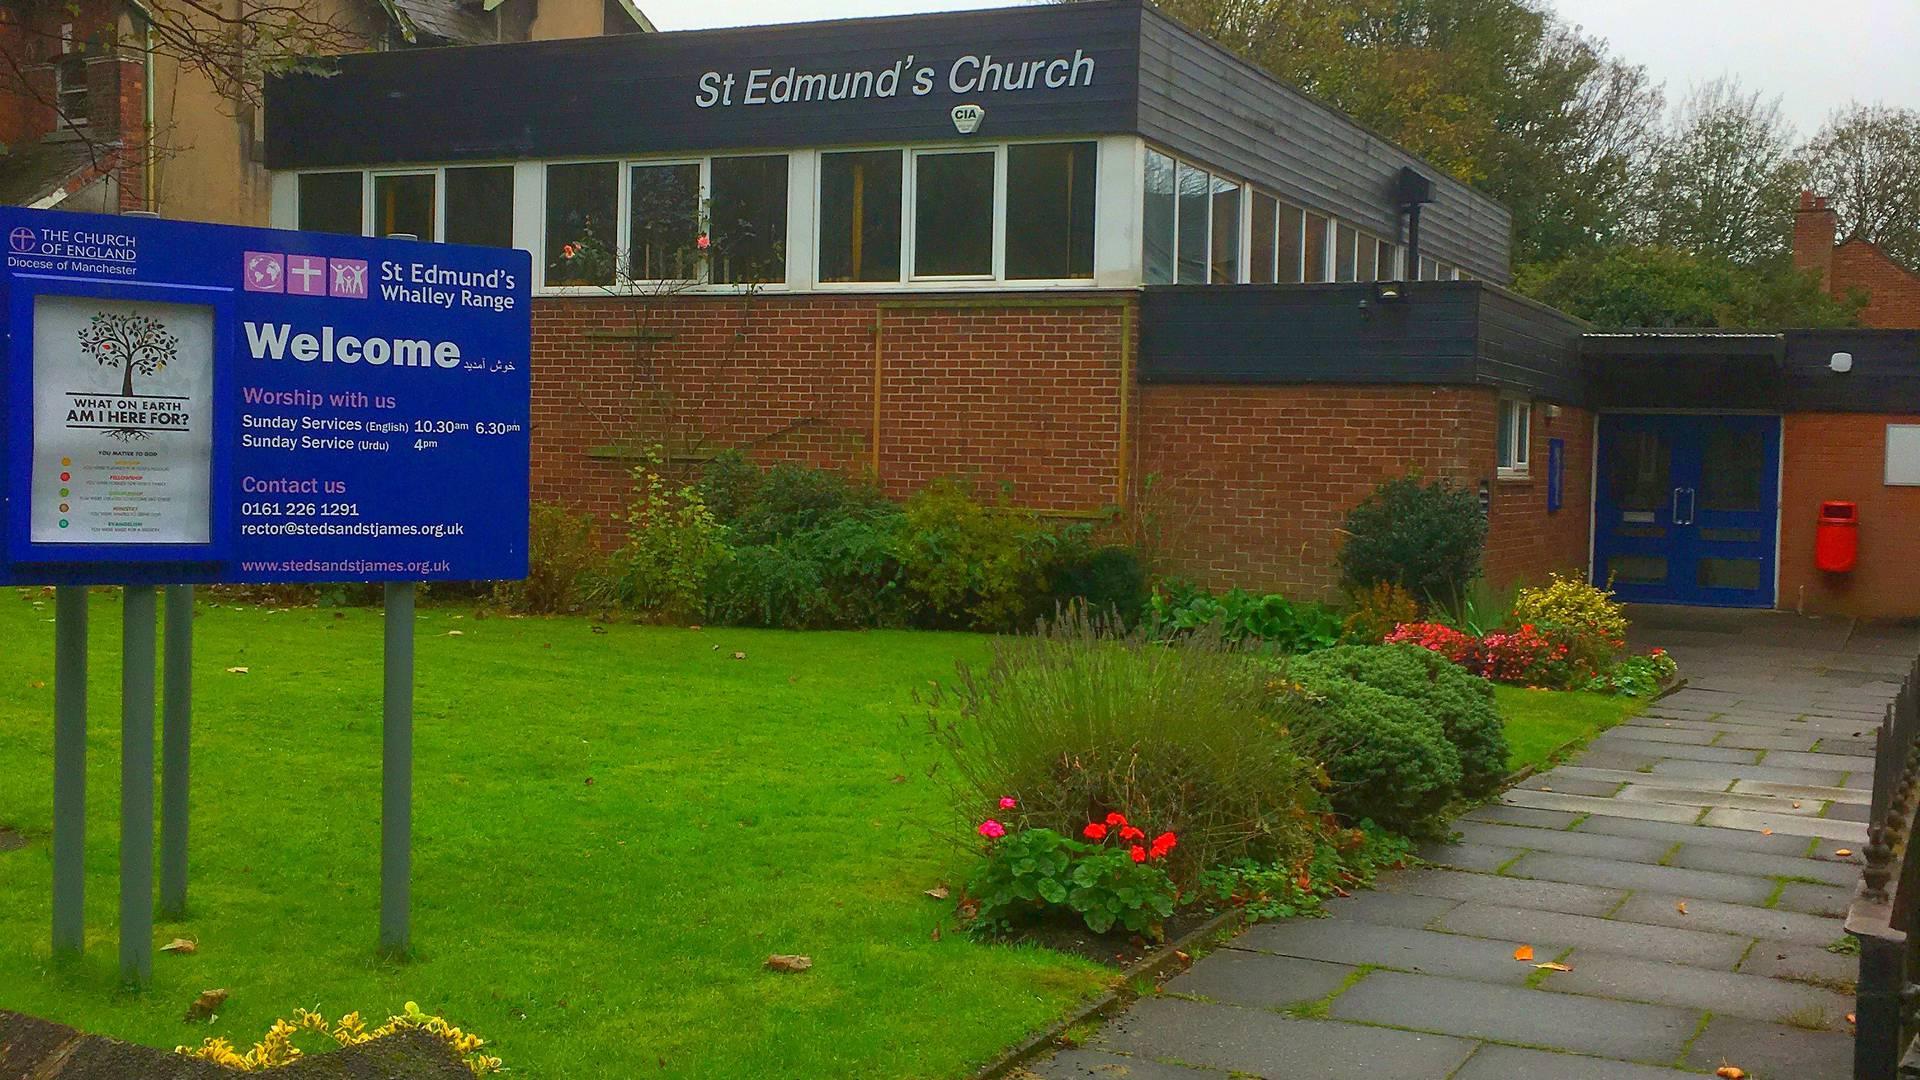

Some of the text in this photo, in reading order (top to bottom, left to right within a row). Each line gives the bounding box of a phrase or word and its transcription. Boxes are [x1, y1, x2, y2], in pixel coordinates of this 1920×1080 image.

[695, 72, 735, 108] St
[948, 49, 1096, 94] Church
[955, 109, 977, 120] CIA
[41, 228, 136, 248] THE CHURCH
[41, 243, 137, 260] OF ENGLAND
[8, 257, 137, 275] Diocese of Manchester
[381, 261, 403, 282] St
[381, 284, 515, 312] Whalley Range
[244, 321, 461, 368] Welcome
[74, 398, 181, 411] WHAT ON EARTH
[242, 387, 396, 409] Worship with us
[66, 410, 190, 426] AM I HERE FOR?
[242, 414, 298, 431] Sunday
[301, 416, 362, 431] Services
[365, 421, 409, 434] (English)
[242, 434, 438, 452] Sunday Service (Urdu) 4pm
[242, 476, 346, 494] Contact us
[241, 502, 359, 516] 0161 226 1291
[241, 522, 464, 537] rector@stedsandstjames.org.uk
[242, 559, 450, 574] www.stedsandstjames.org.uk
